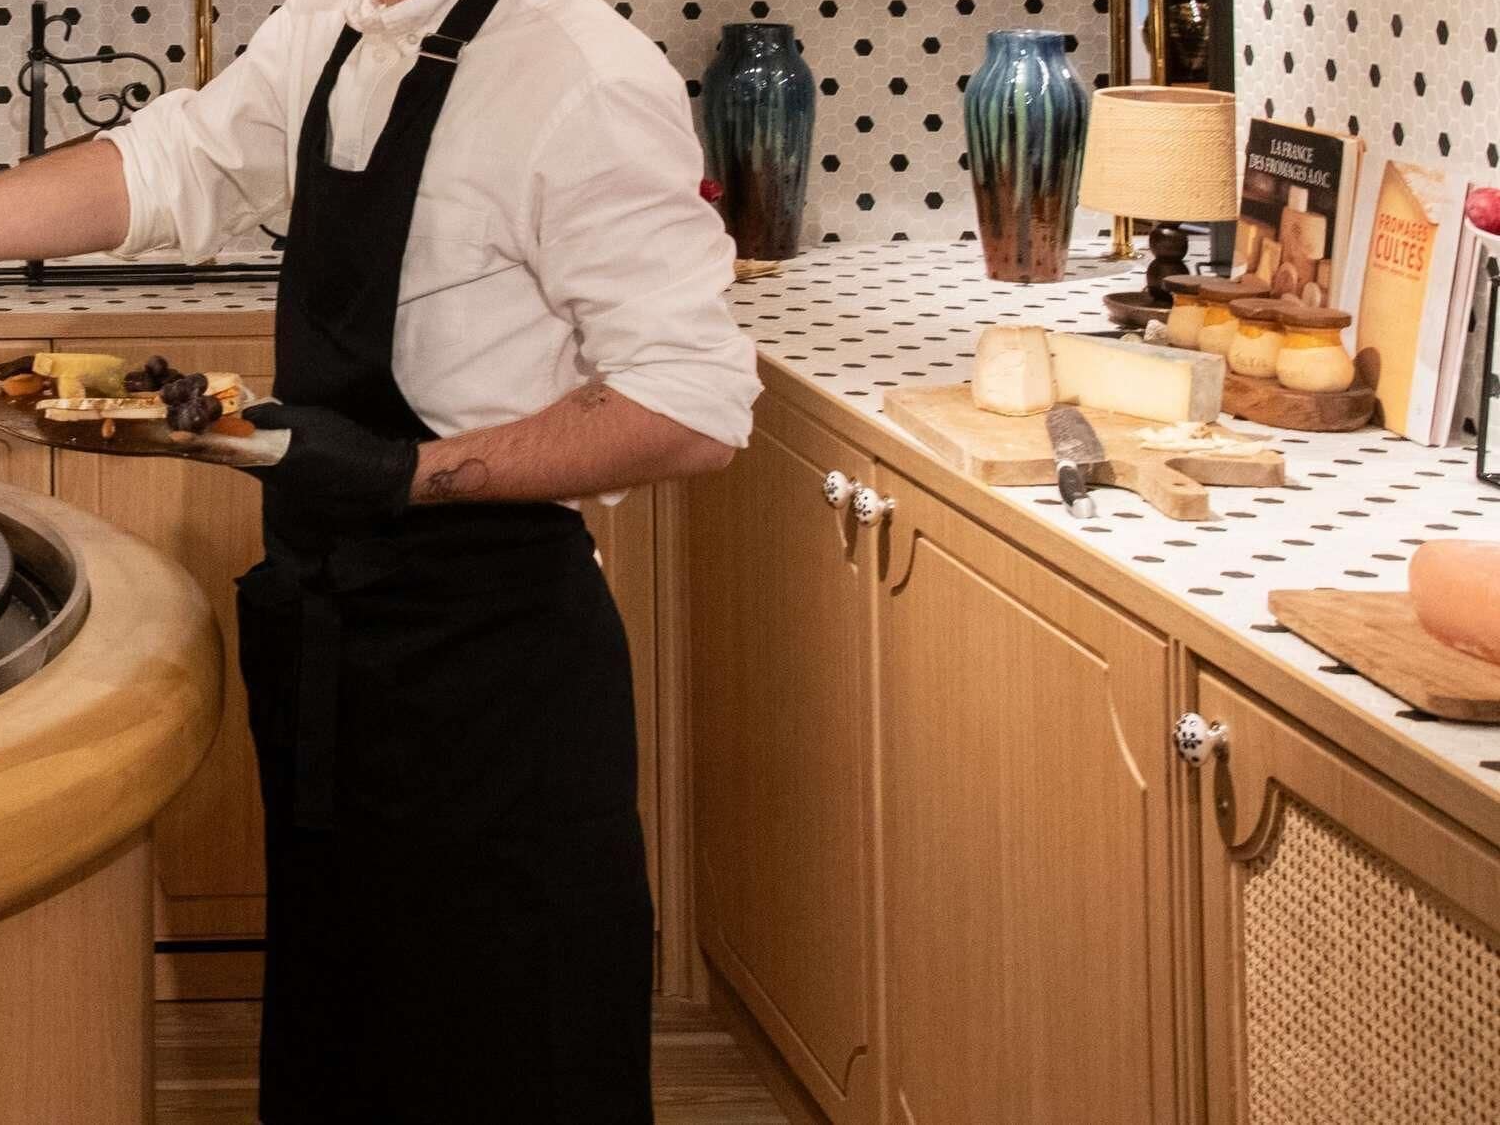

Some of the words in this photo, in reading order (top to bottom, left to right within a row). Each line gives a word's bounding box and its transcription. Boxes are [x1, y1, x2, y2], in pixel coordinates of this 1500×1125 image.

[1269, 138, 1282, 155] LA
[1281, 141, 1315, 164] FRANCE
[1249, 153, 1265, 171] DES
[1264, 156, 1307, 183] FROMAGES
[1379, 213, 1429, 243] FROMAGES
[1375, 234, 1425, 272] CULTES
